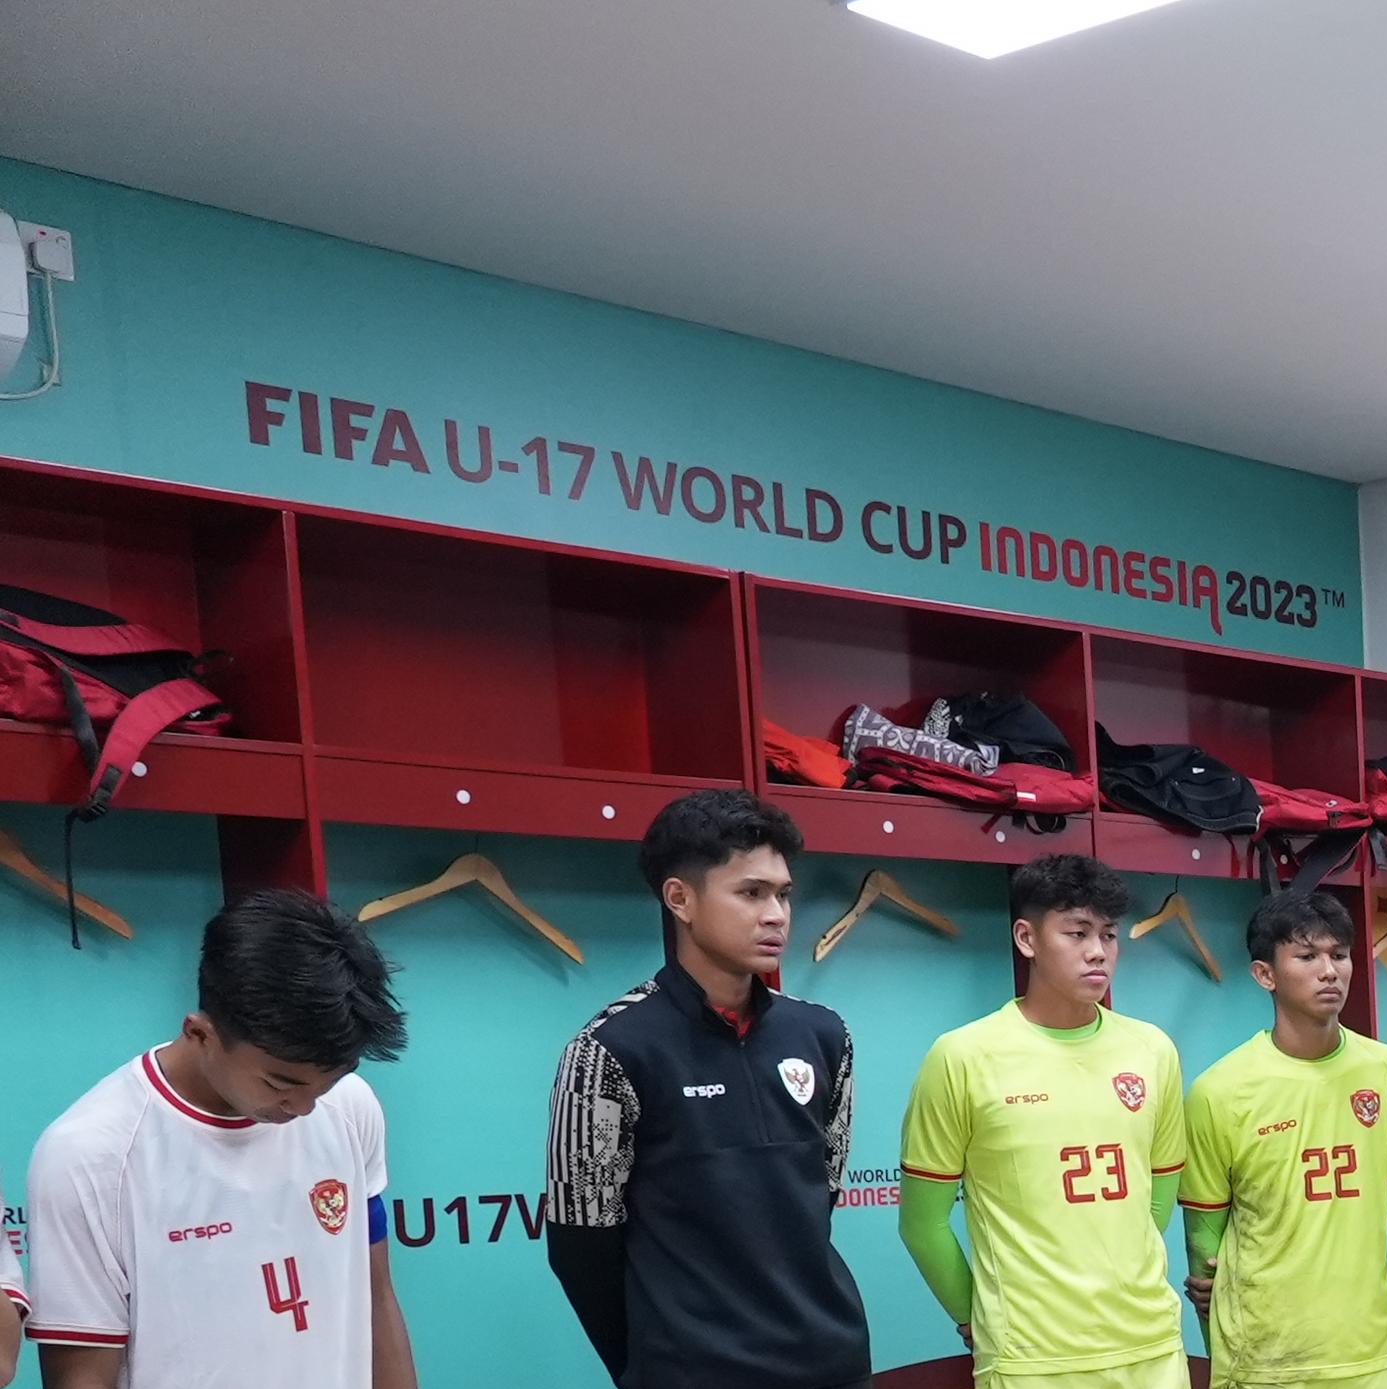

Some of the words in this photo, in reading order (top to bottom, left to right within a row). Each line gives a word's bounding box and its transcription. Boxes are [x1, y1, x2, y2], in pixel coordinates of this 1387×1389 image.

[245, 381, 431, 474] FIFA
[444, 419, 596, 502] U-17
[611, 451, 843, 543] WORLD
[861, 501, 967, 564] CUP
[979, 521, 1223, 636] INDONESIA
[683, 1084, 726, 1098] erspo
[1005, 1093, 1049, 1105] erspo
[1258, 1119, 1297, 1136] erspo
[1060, 1143, 1128, 1204] 23
[1301, 1144, 1360, 1201] 22
[168, 1222, 233, 1243] erspo
[261, 1256, 310, 1333] 4
